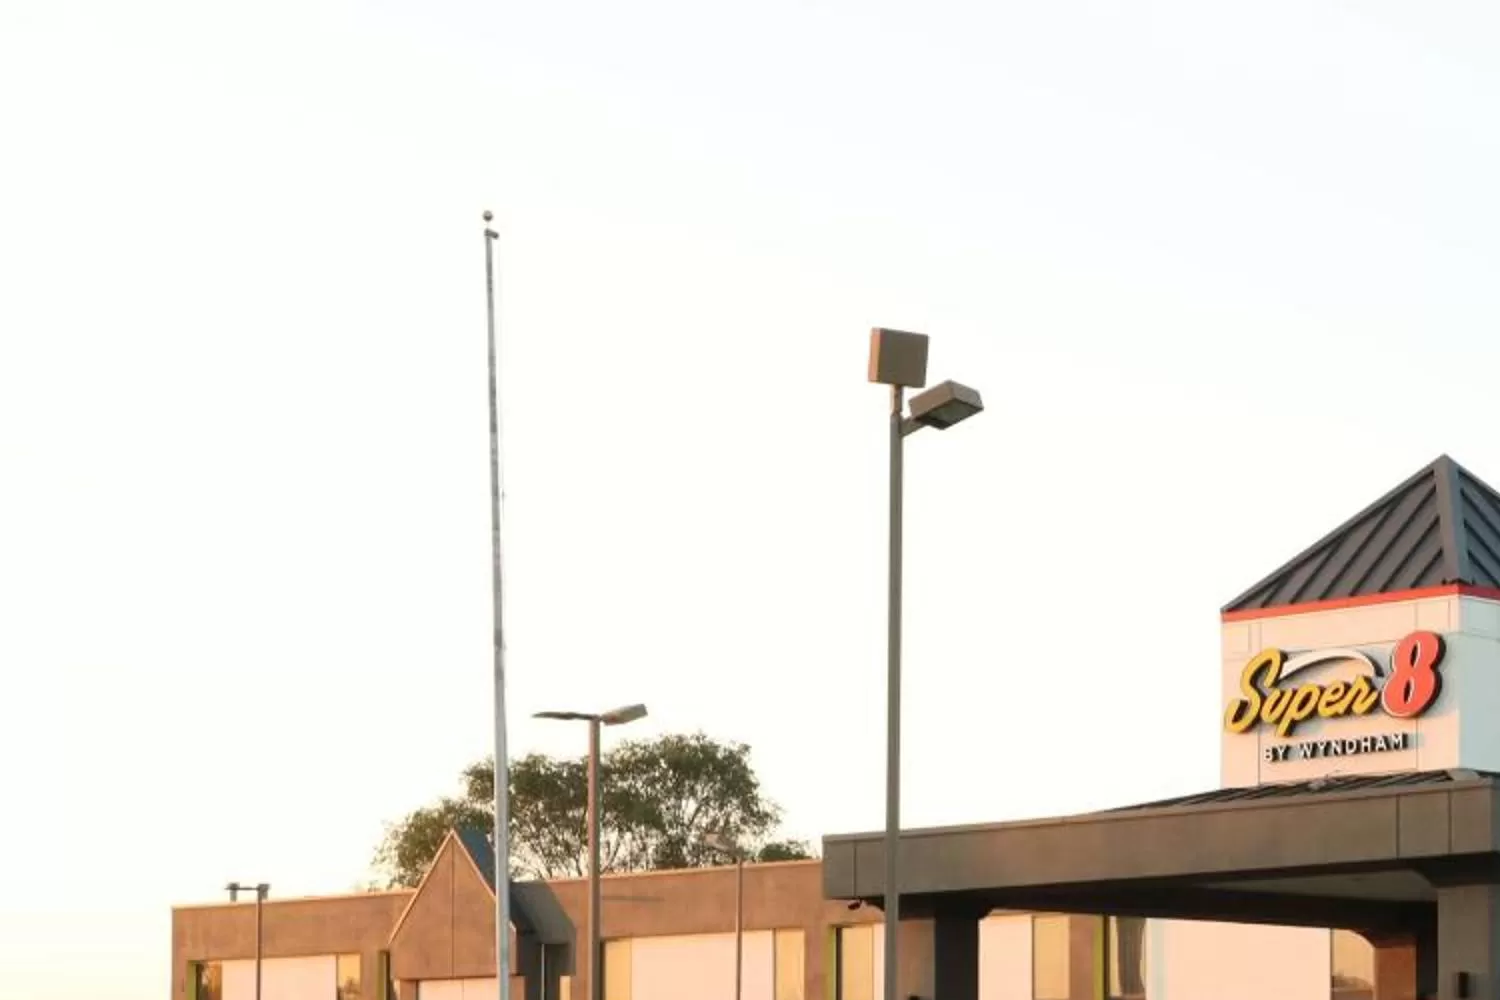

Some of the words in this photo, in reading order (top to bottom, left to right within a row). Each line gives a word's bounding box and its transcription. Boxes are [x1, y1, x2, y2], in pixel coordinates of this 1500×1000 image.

[1224, 647, 1380, 737] Super
[1382, 630, 1443, 718] 8
[1264, 744, 1290, 763] BY
[1300, 732, 1409, 761] WYNDHAM
